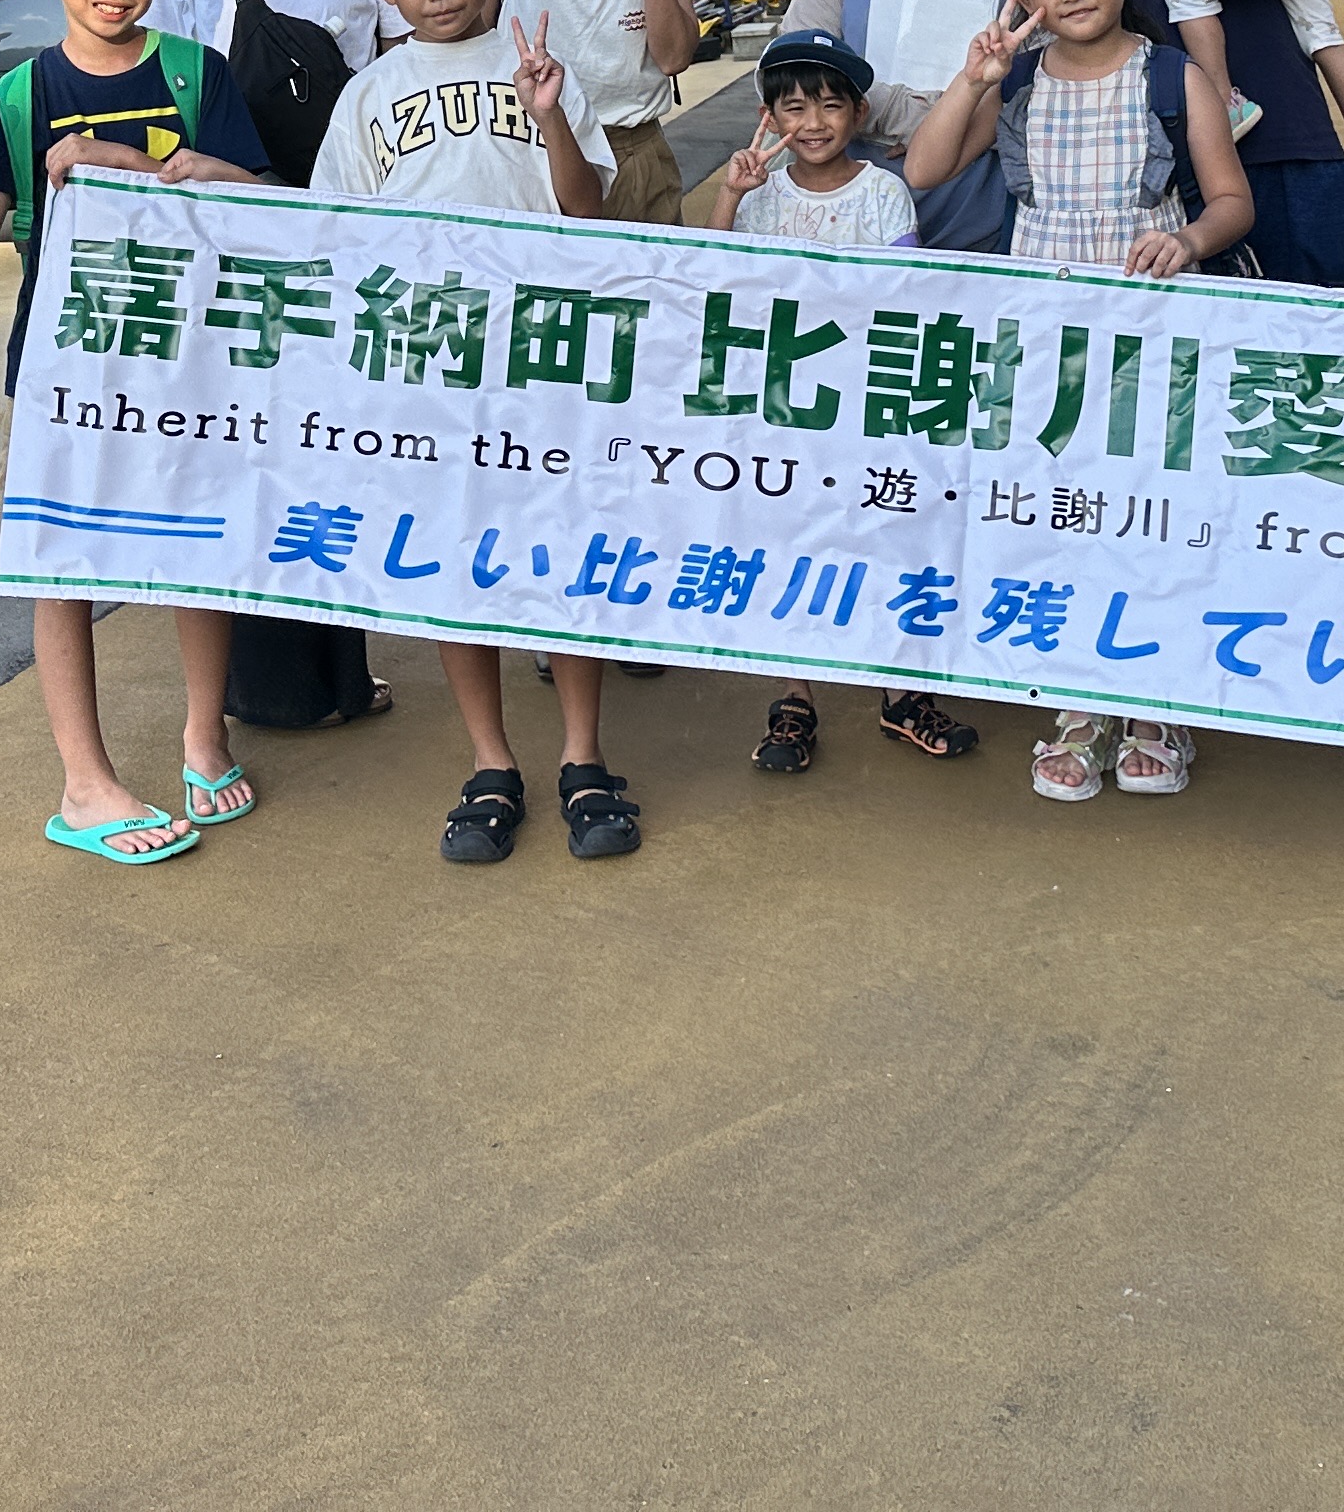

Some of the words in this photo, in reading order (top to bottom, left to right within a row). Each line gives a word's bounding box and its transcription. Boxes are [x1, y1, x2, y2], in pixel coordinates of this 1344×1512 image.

[370, 80, 547, 185] AZUR
[49, 386, 268, 445] Inherit
[299, 411, 439, 462] from
[471, 431, 571, 475] the
